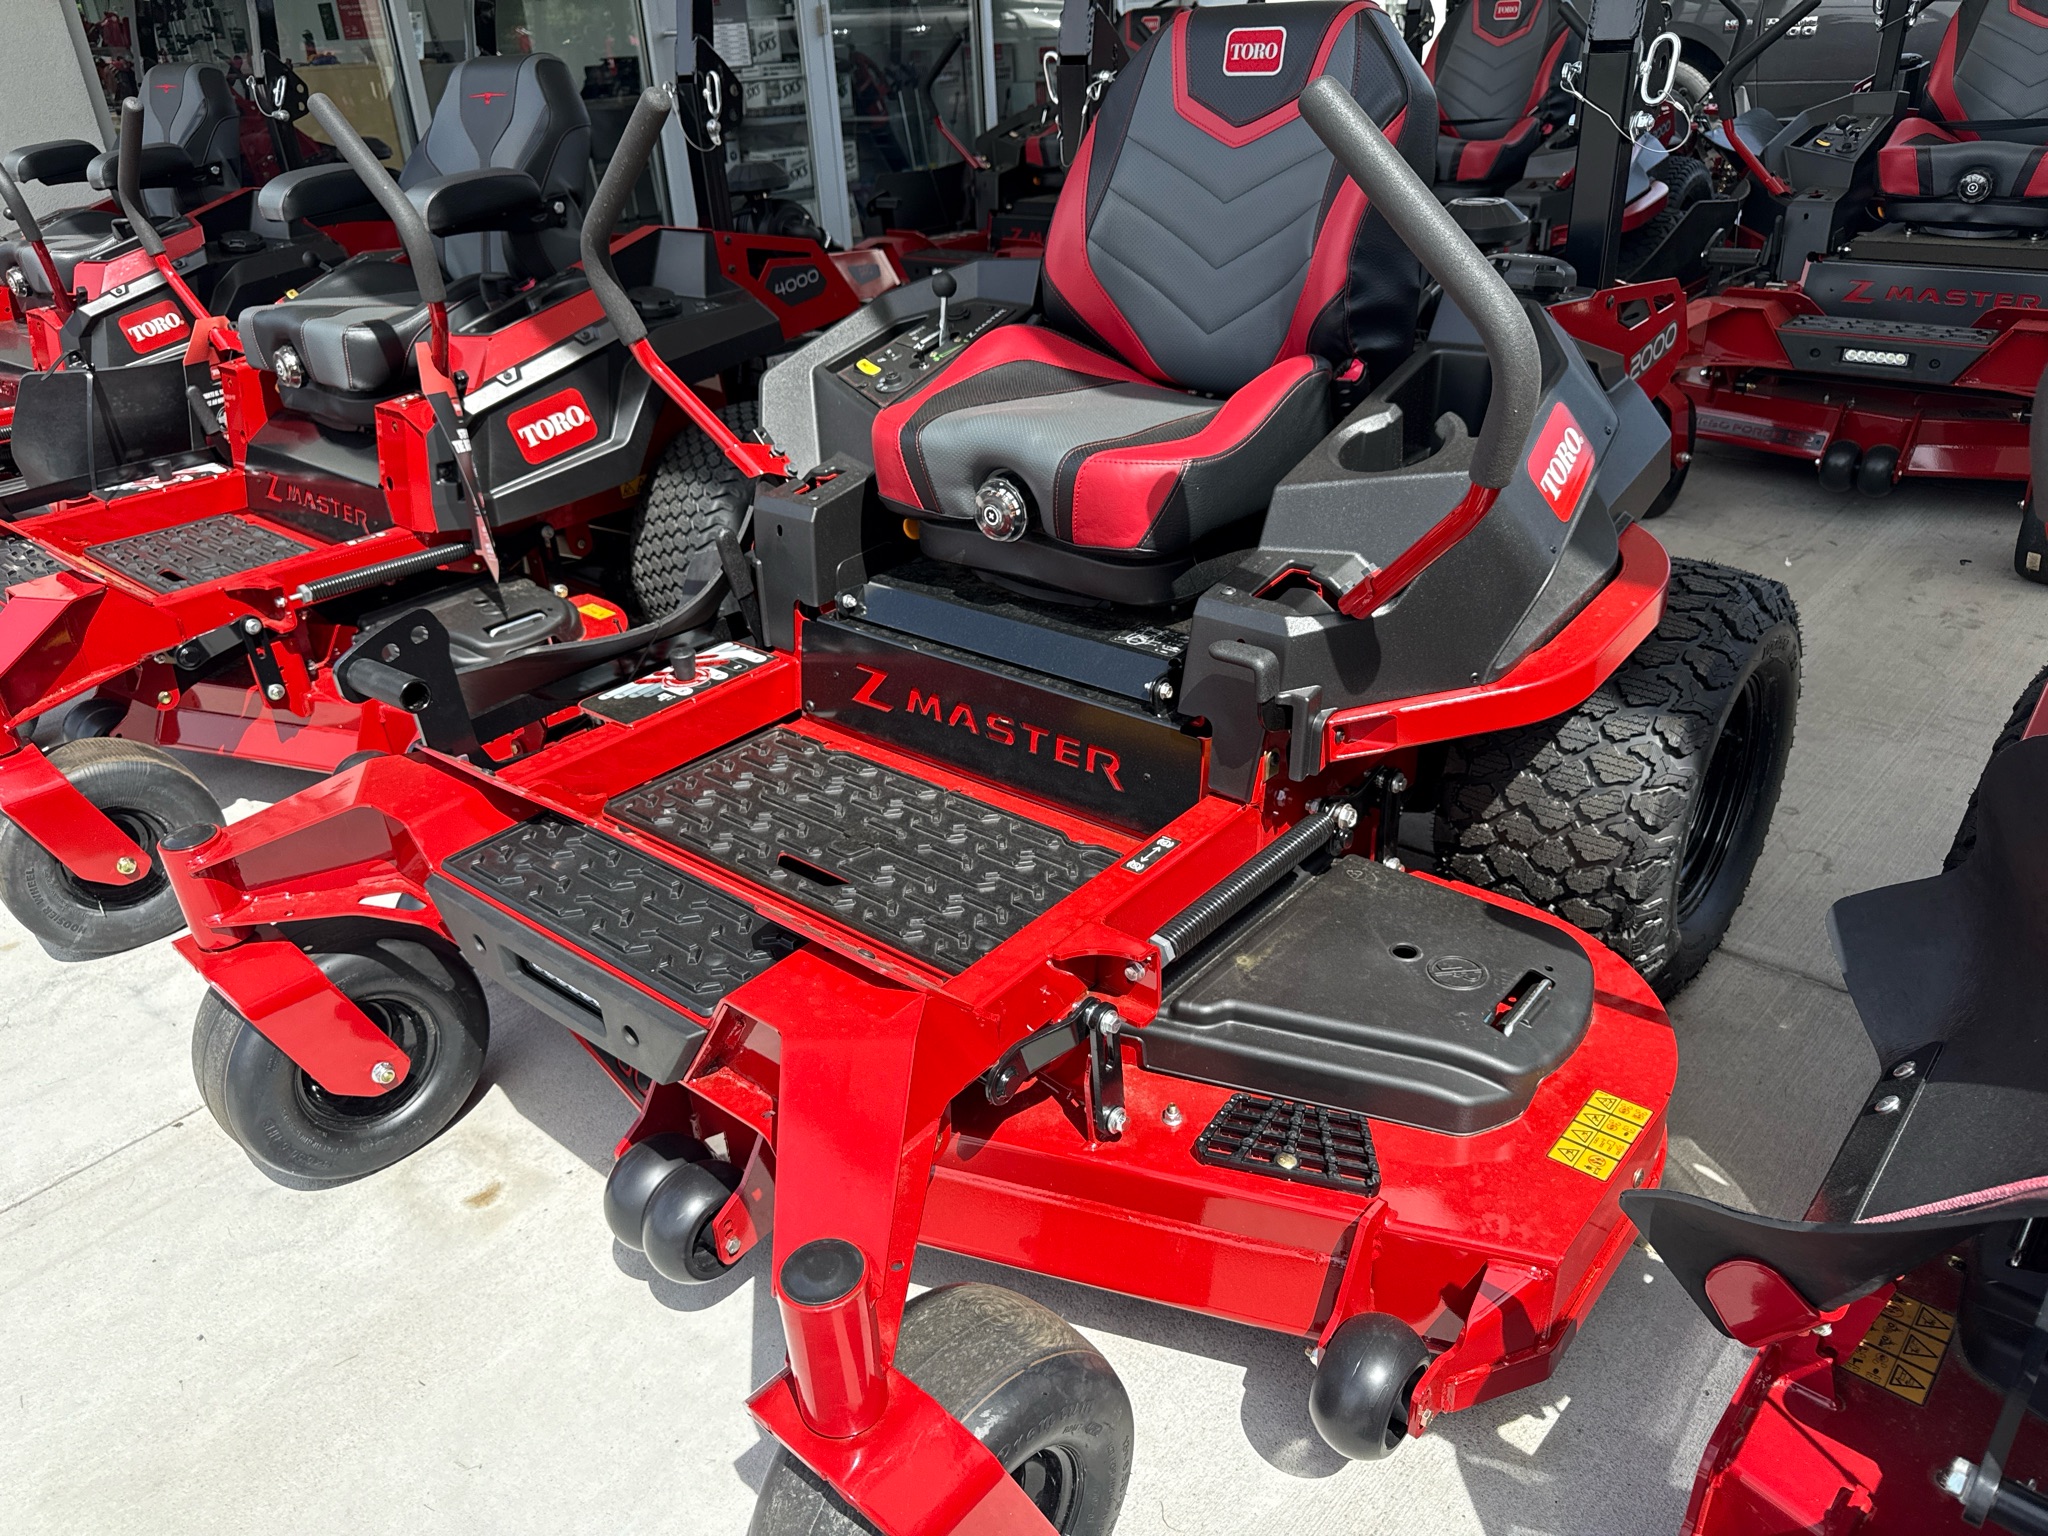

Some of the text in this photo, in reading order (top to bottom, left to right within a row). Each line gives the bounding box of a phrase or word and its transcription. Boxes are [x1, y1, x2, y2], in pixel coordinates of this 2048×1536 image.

[1231, 42, 1278, 60] TORO
[774, 269, 819, 296] 4000
[1841, 279, 2043, 309] Z MASTER
[1630, 322, 1677, 380] 2000
[265, 473, 370, 535] Z MASTER
[852, 662, 1125, 793] Z MASTER
[25, 868, 43, 906] WHEEL
[42, 906, 87, 934] HOOSIER
